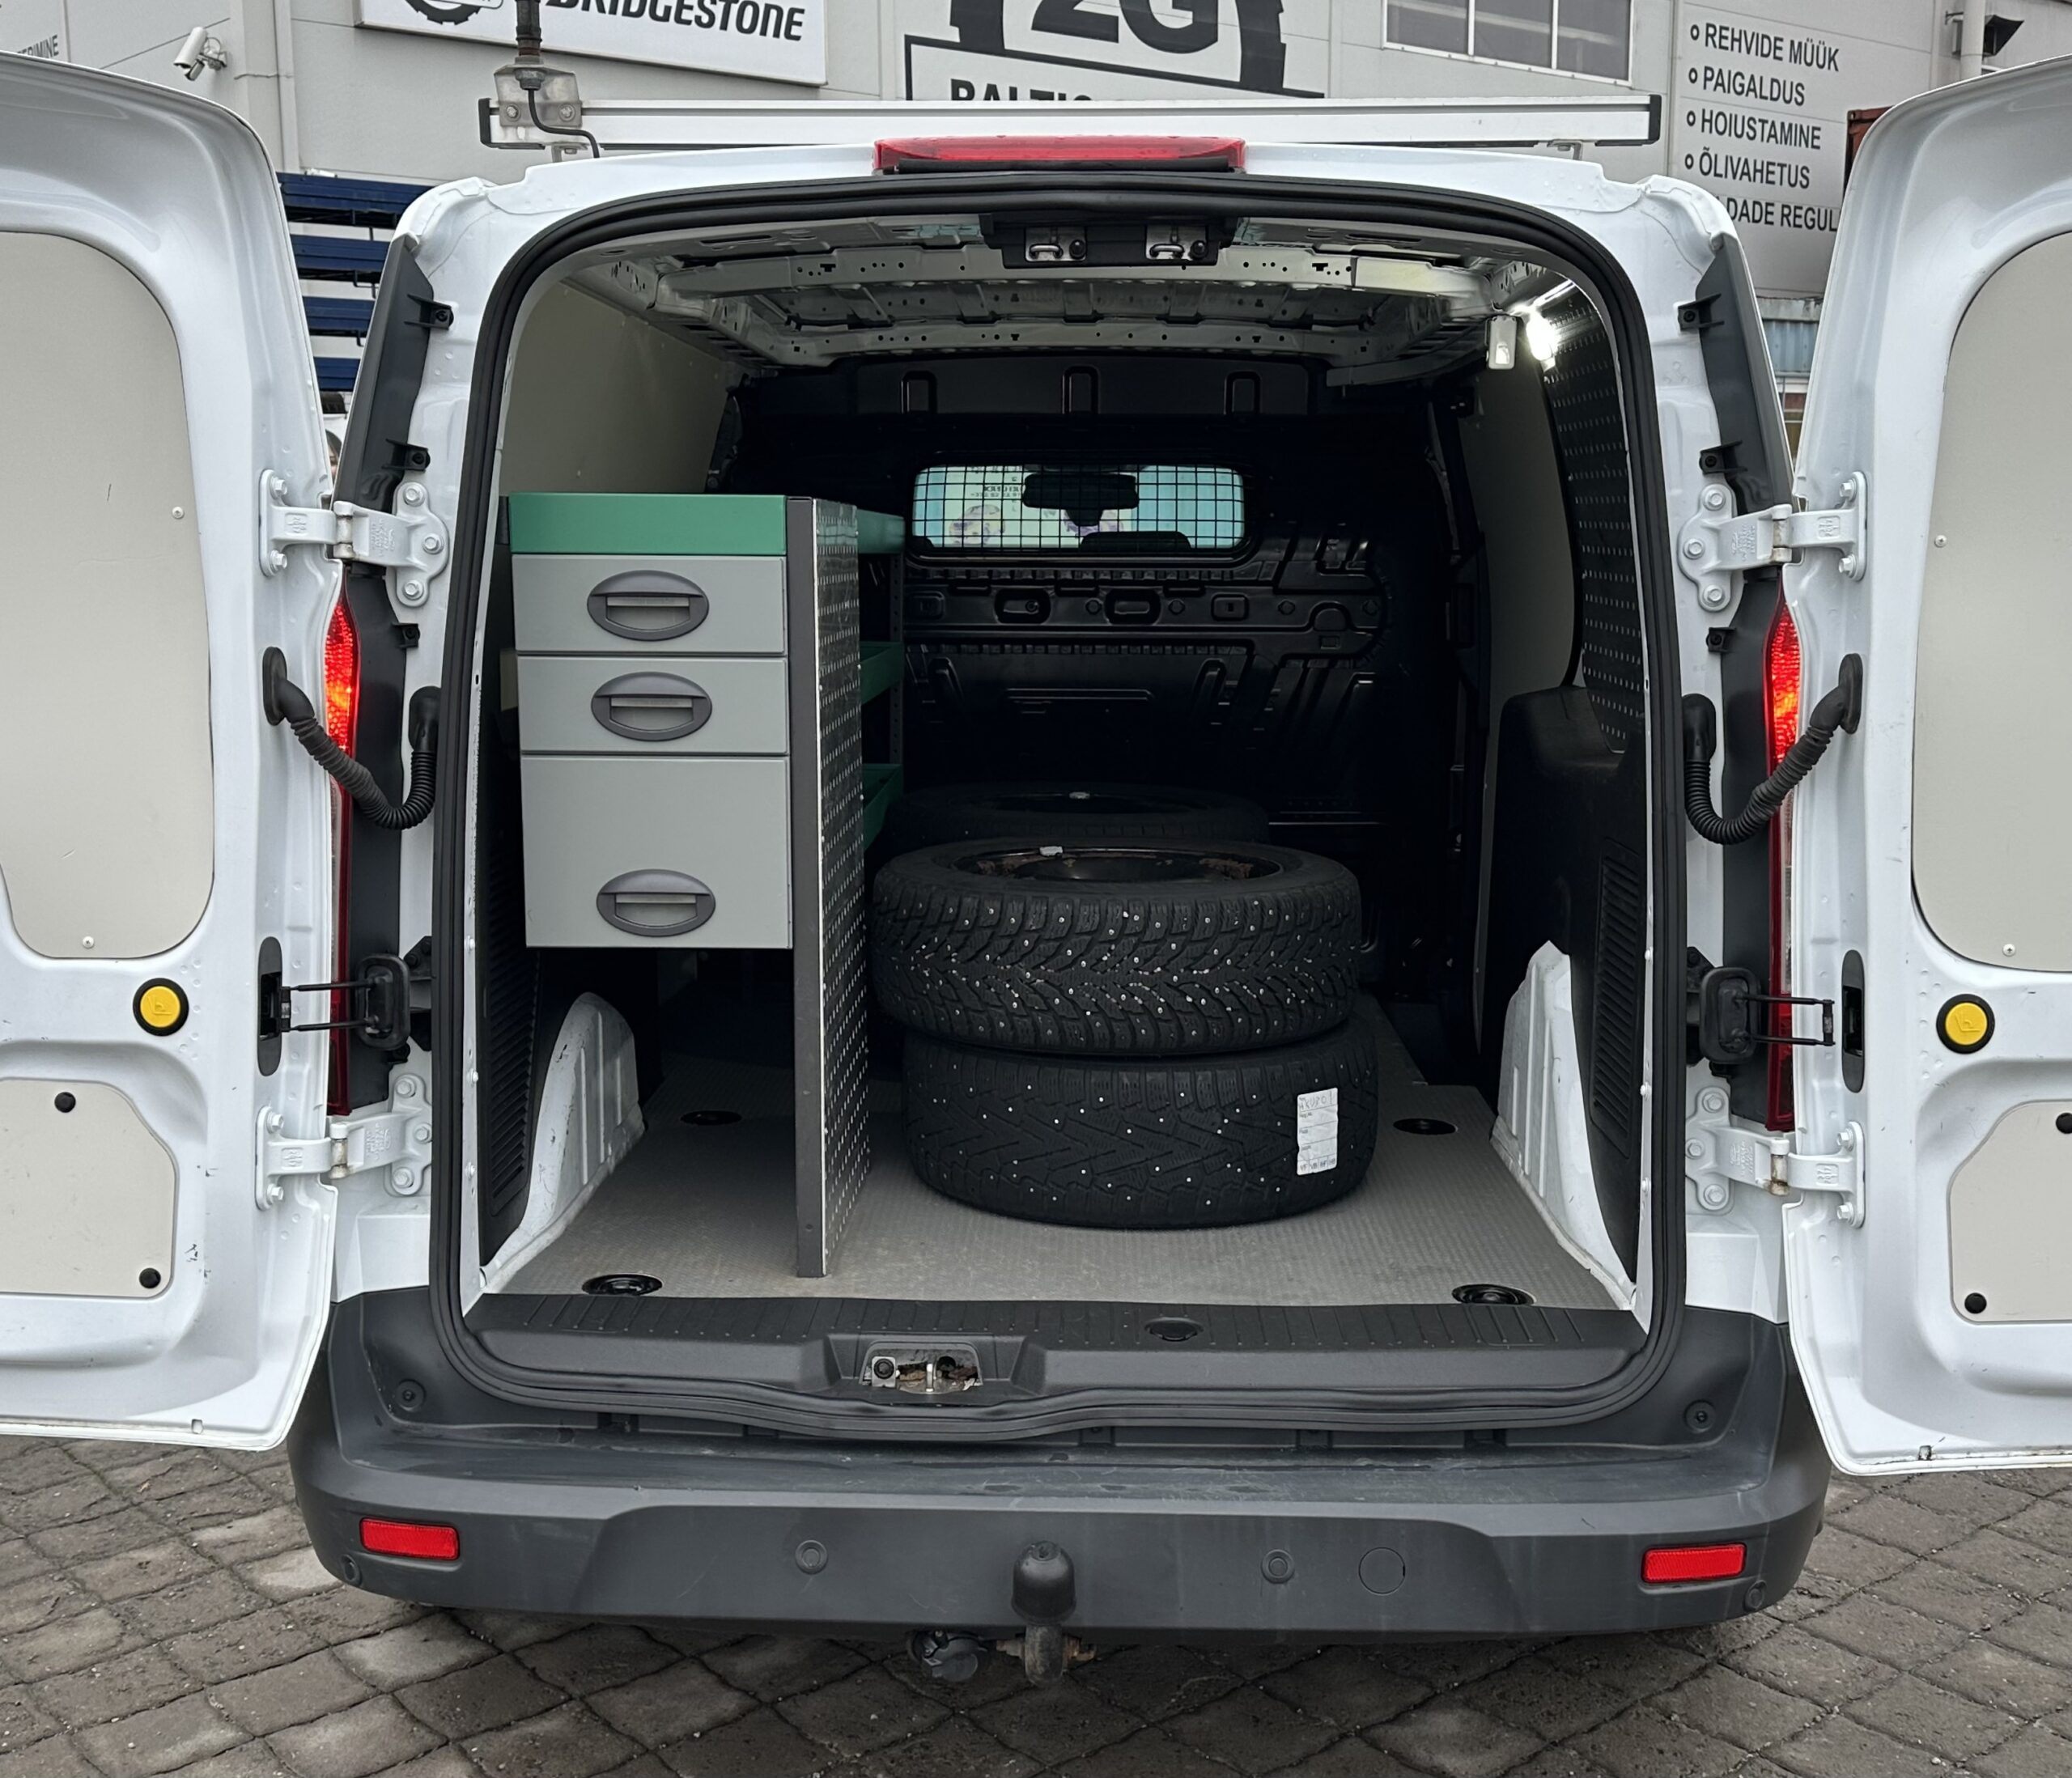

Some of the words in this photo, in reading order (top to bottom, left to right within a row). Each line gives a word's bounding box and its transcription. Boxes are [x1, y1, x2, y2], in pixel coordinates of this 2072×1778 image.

[545, 0, 805, 41] DGESTONE
[1705, 22, 1784, 62] REHVIDE
[1788, 37, 1840, 72] MÜÜK
[1703, 66, 1805, 107] PAIGALDUS
[1701, 108, 1821, 150] HOIUSTAMINE
[1699, 146, 1811, 189] ÕLIVAHETUS
[1716, 196, 1775, 226] DADE
[1780, 204, 1841, 232] REGUL
